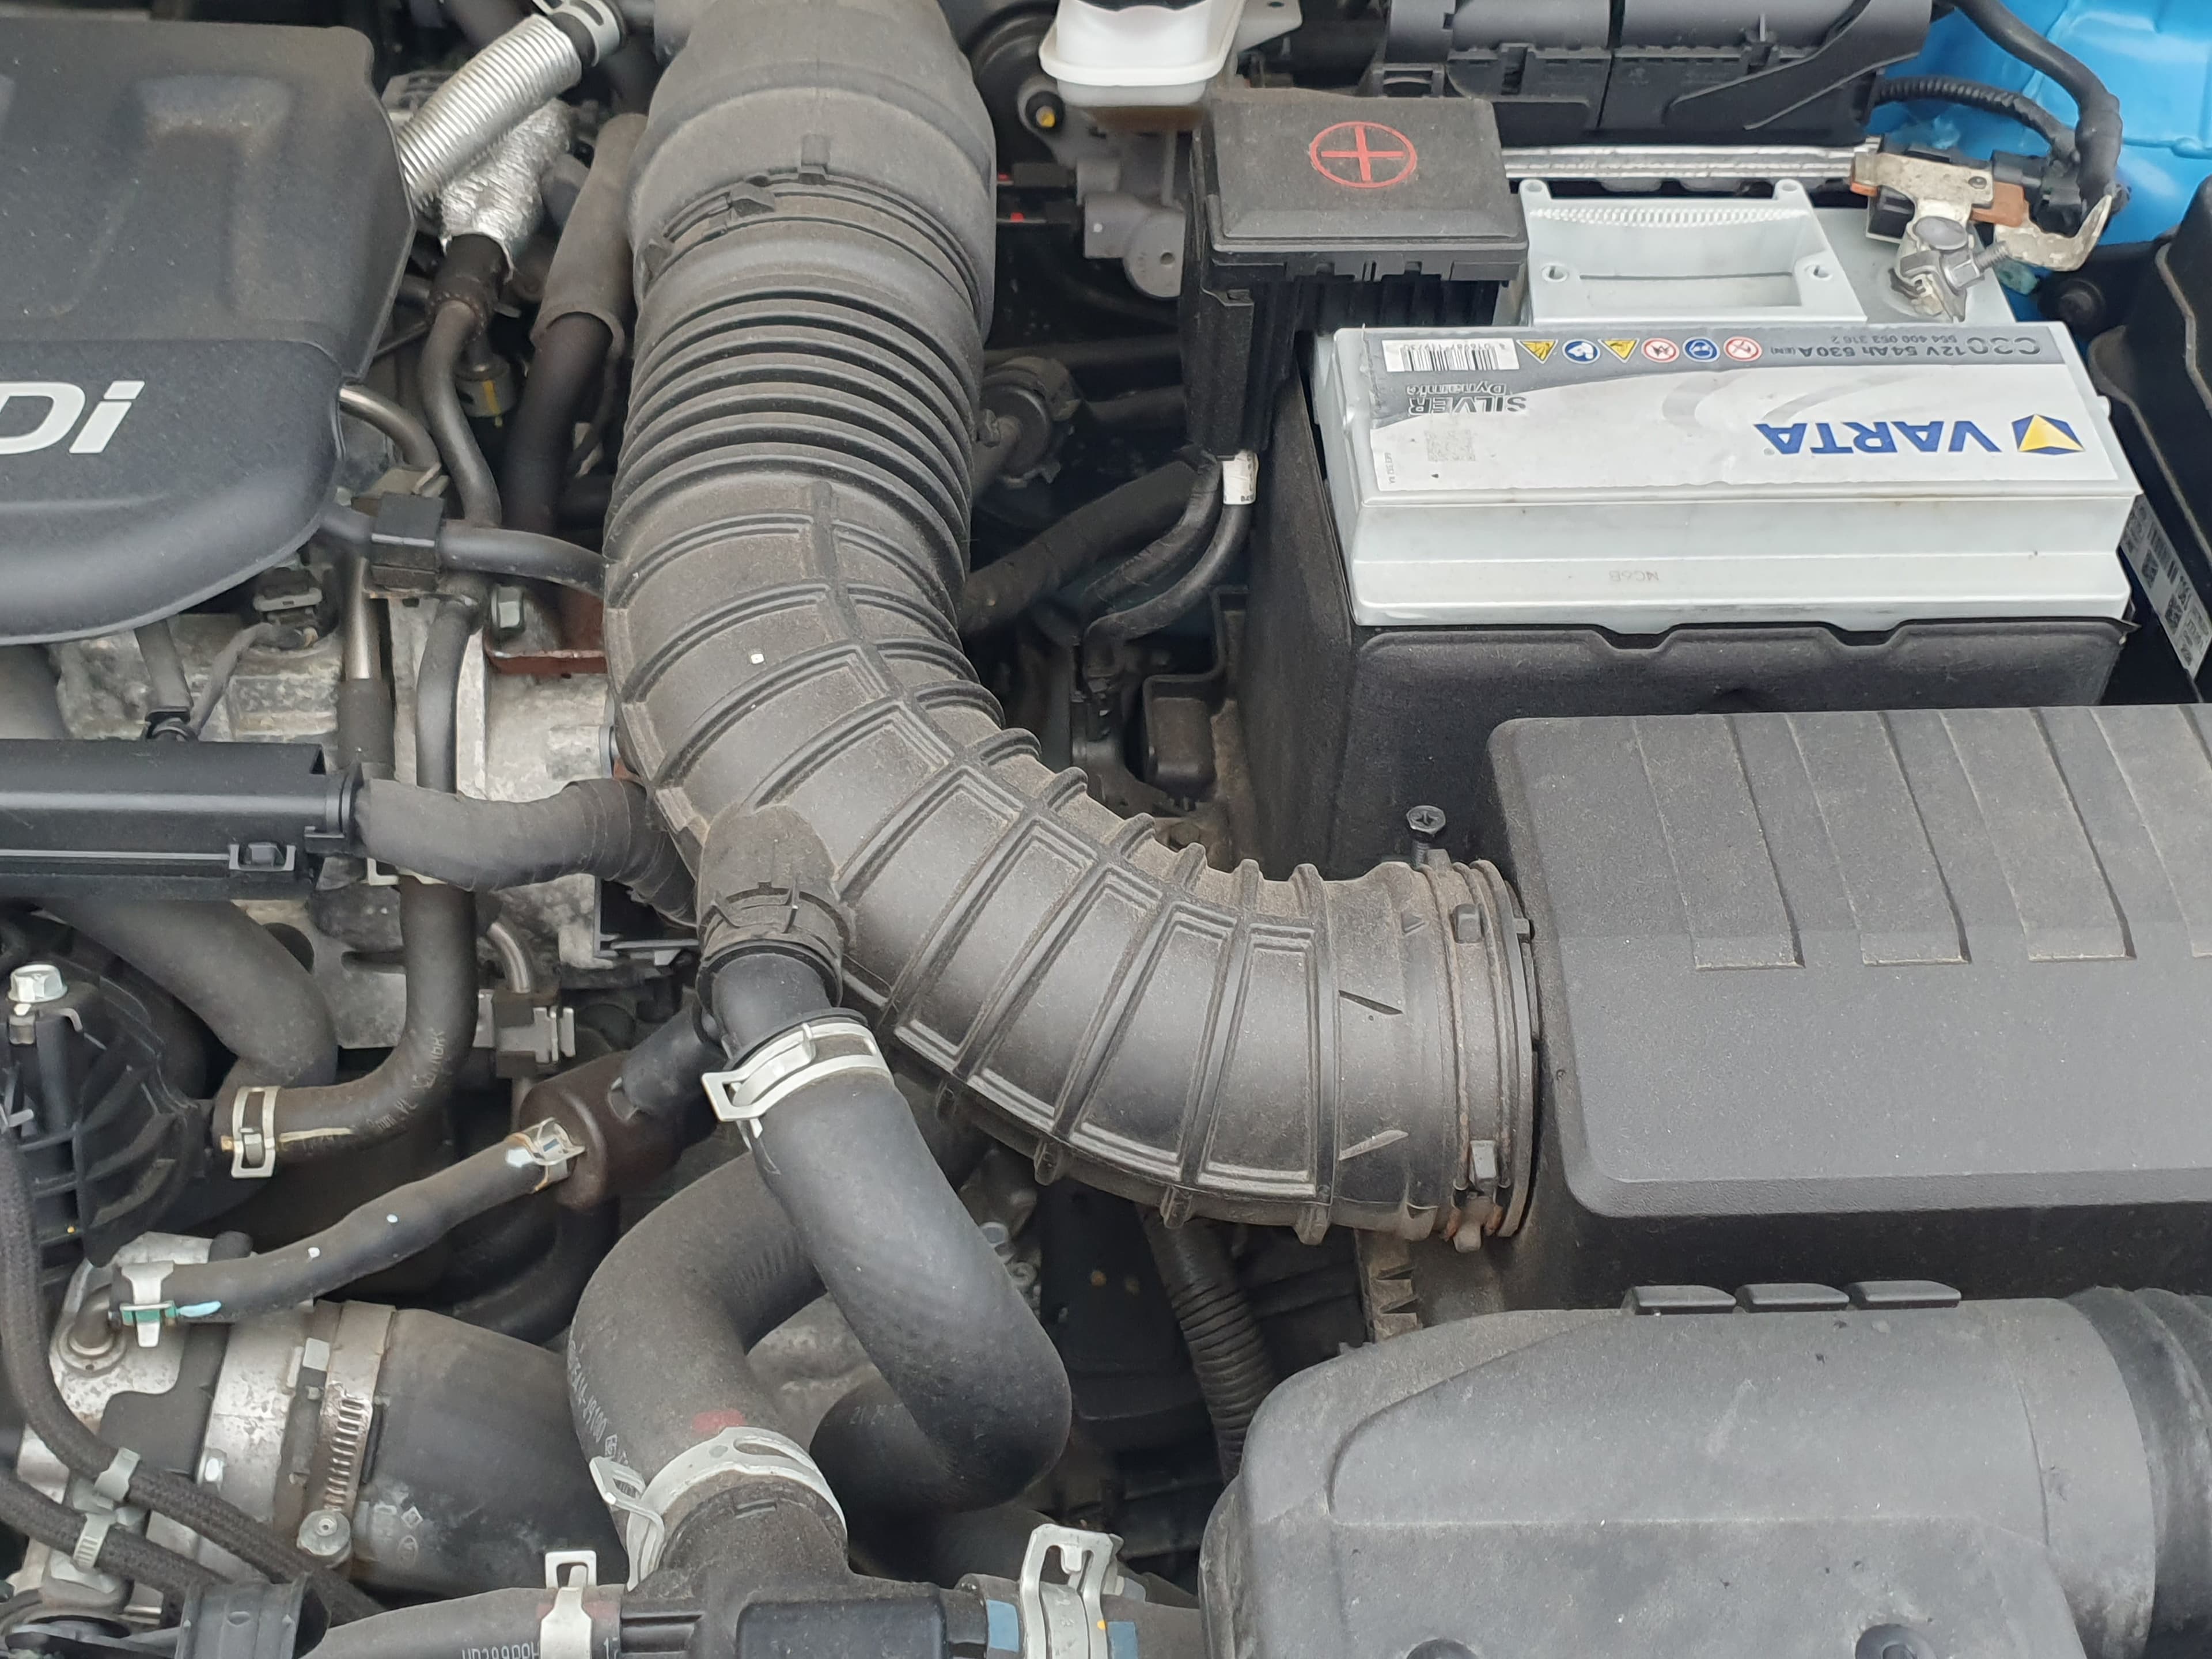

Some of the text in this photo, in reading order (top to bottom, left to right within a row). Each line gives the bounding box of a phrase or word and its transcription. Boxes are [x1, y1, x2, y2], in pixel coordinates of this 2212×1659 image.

[1861, 346, 1918, 357] 54Ah
[1926, 346, 1967, 357] 12V
[1966, 336, 2040, 355] C30
[1407, 381, 1507, 397] Dynamic
[1408, 396, 1527, 414] SILVER
[1753, 421, 2003, 454] VARTA
